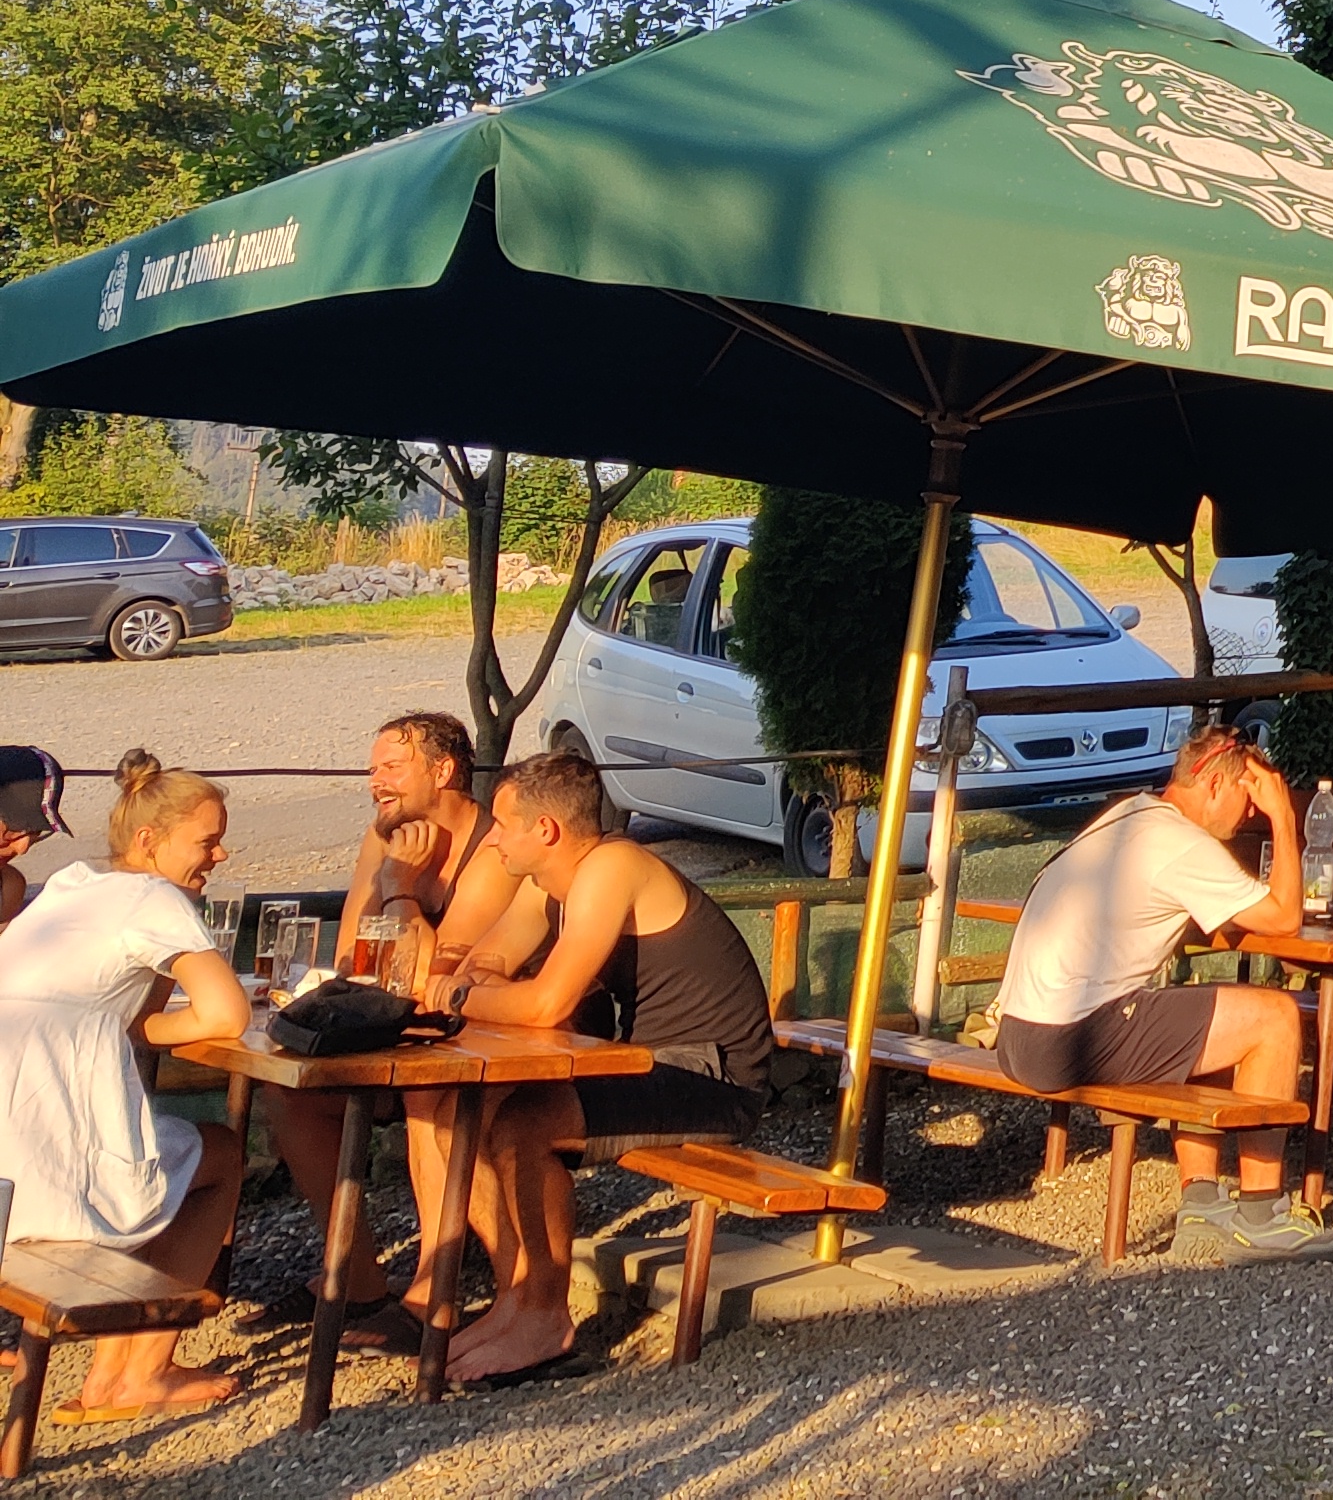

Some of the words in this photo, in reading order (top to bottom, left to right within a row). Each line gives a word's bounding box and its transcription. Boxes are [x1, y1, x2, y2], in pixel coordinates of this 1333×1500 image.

[135, 255, 176, 300] ŽIVOT
[170, 251, 190, 291] JE
[186, 229, 236, 285] HOŘKÝ.
[233, 215, 299, 275] BOHUDÍK.
